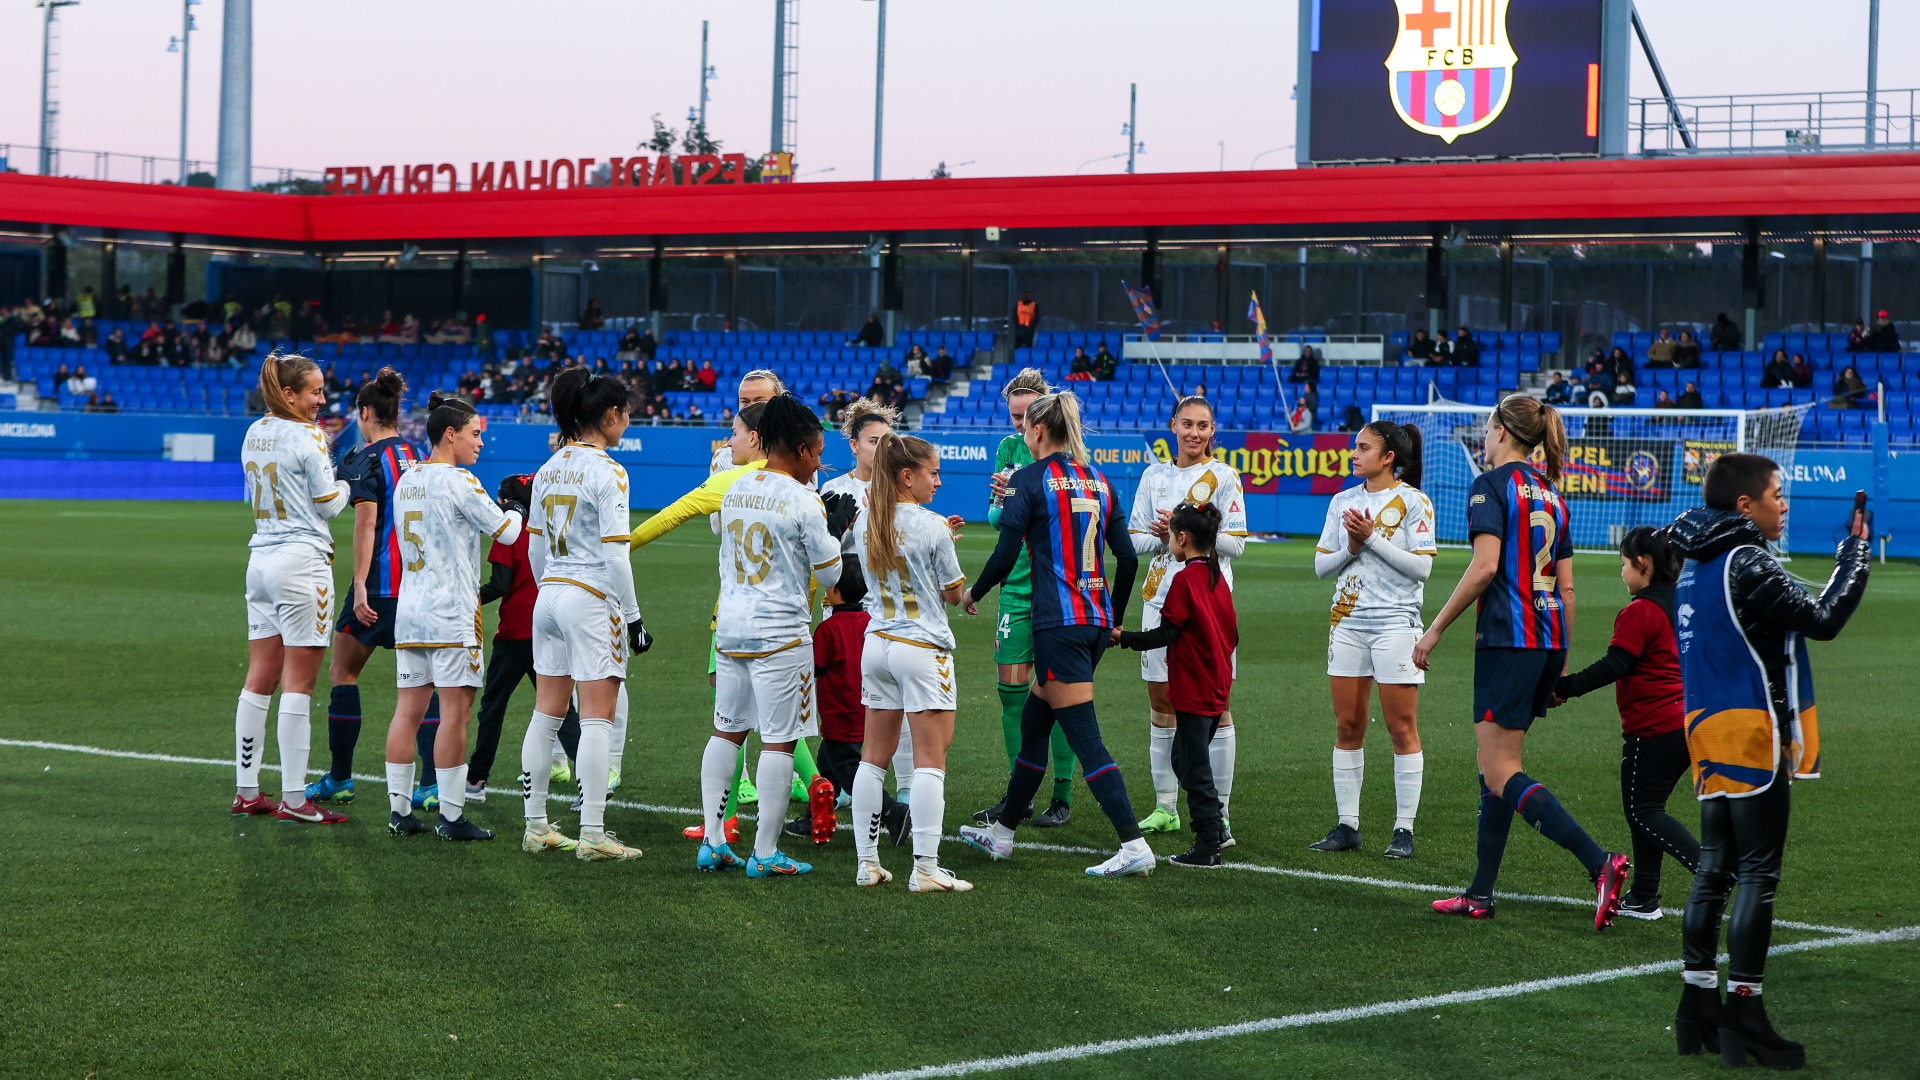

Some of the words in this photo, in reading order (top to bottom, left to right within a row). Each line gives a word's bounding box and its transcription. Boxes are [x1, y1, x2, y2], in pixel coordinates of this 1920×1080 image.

[1427, 48, 1474, 67] FCB
[247, 438, 278, 452] MRABET
[932, 444, 987, 461] RCELONA
[1094, 448, 1120, 466] QUE
[1122, 449, 1141, 464] UN
[1569, 446, 1612, 467] PEL
[540, 469, 561, 485] YANG
[563, 470, 584, 486] LINA
[245, 461, 287, 521] 21
[399, 486, 426, 501] NURIA
[541, 494, 577, 557] 17
[1070, 497, 1101, 572] 7
[403, 510, 425, 573] 5
[727, 518, 774, 586] 19
[1529, 510, 1557, 593] 2
